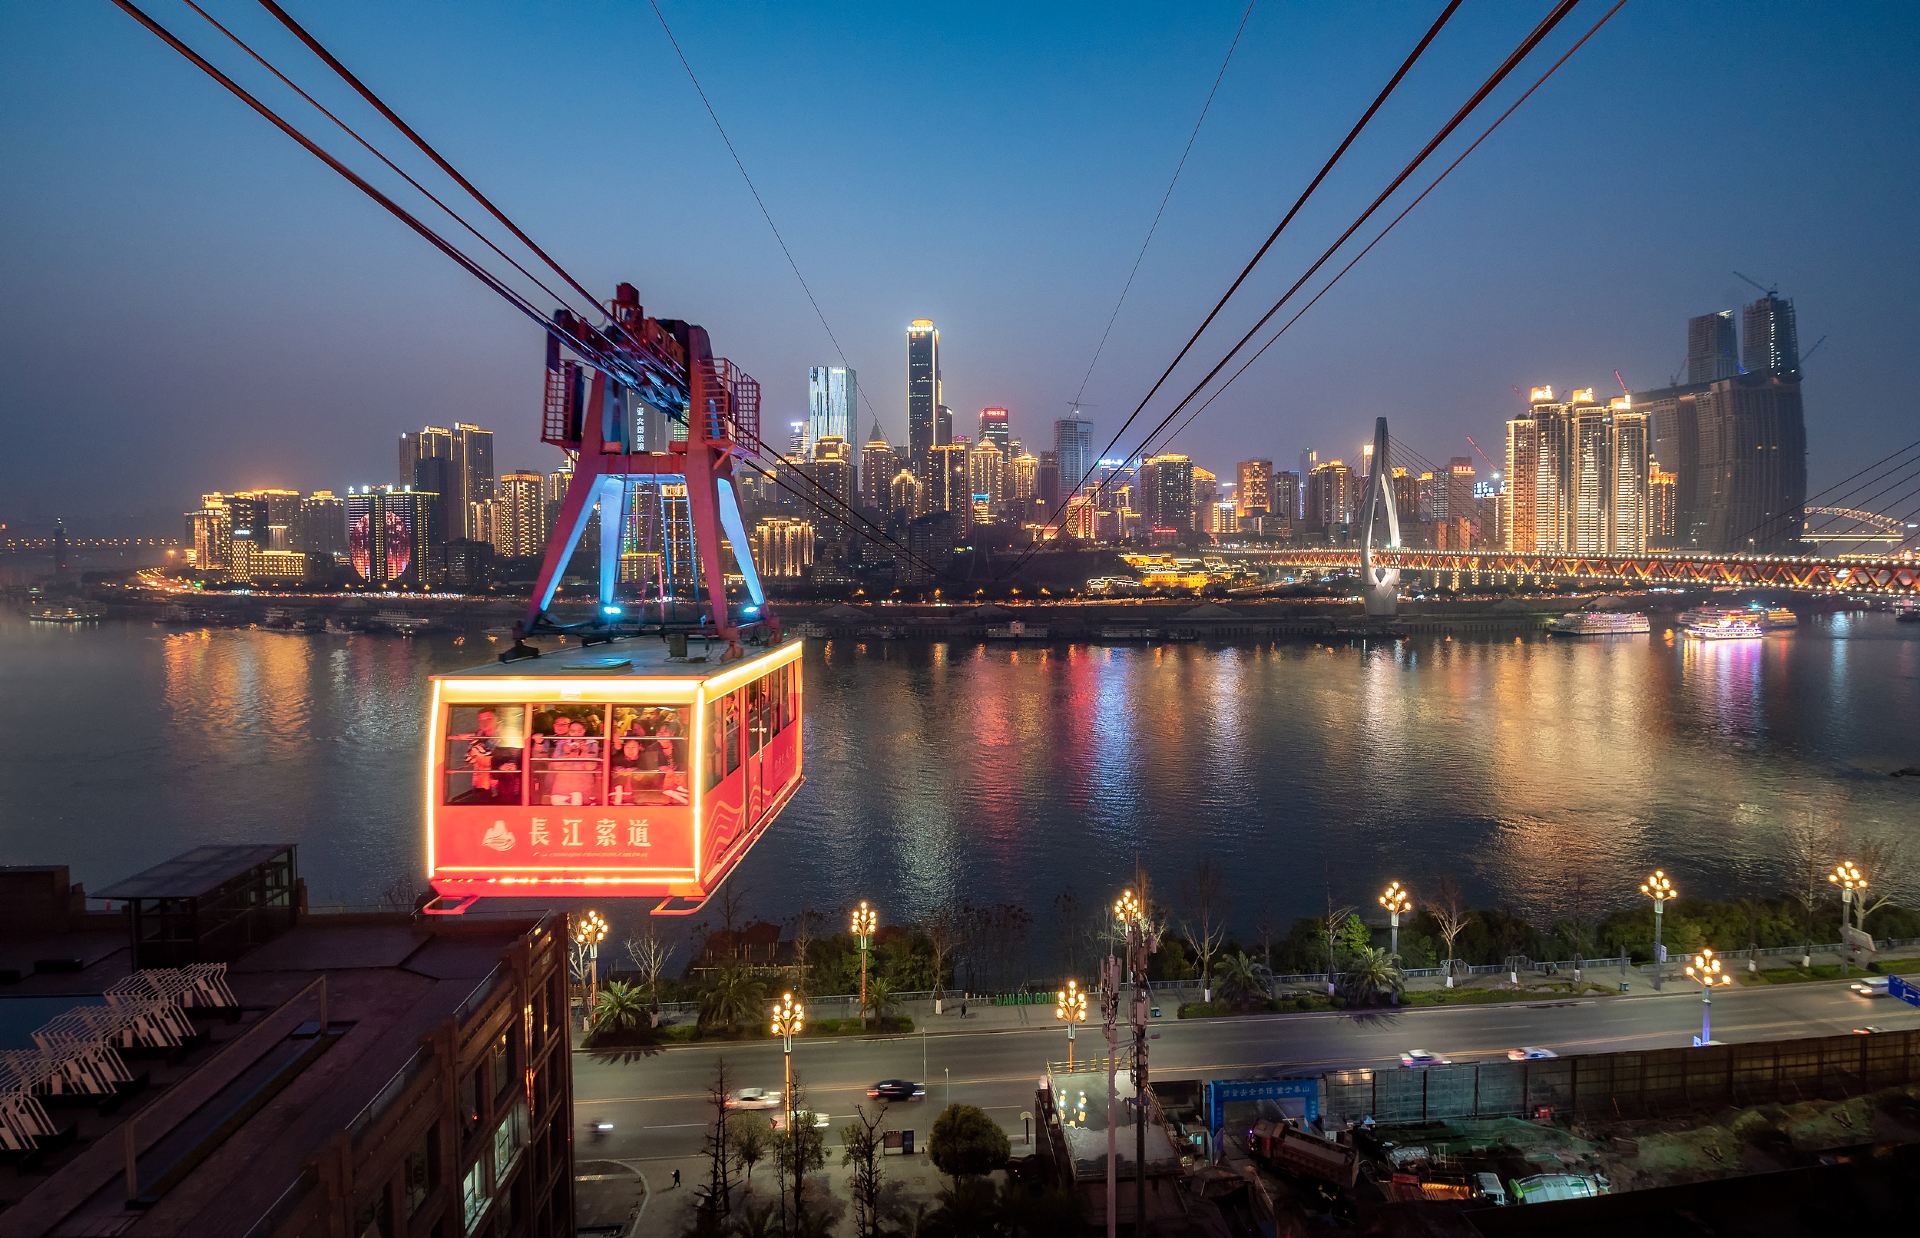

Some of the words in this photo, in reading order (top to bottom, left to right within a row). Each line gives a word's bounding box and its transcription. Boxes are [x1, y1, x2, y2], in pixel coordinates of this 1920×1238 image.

[529, 817, 652, 847] 長江索道
[996, 993, 1015, 1007] NAN
[1018, 992, 1033, 1006] BIN
